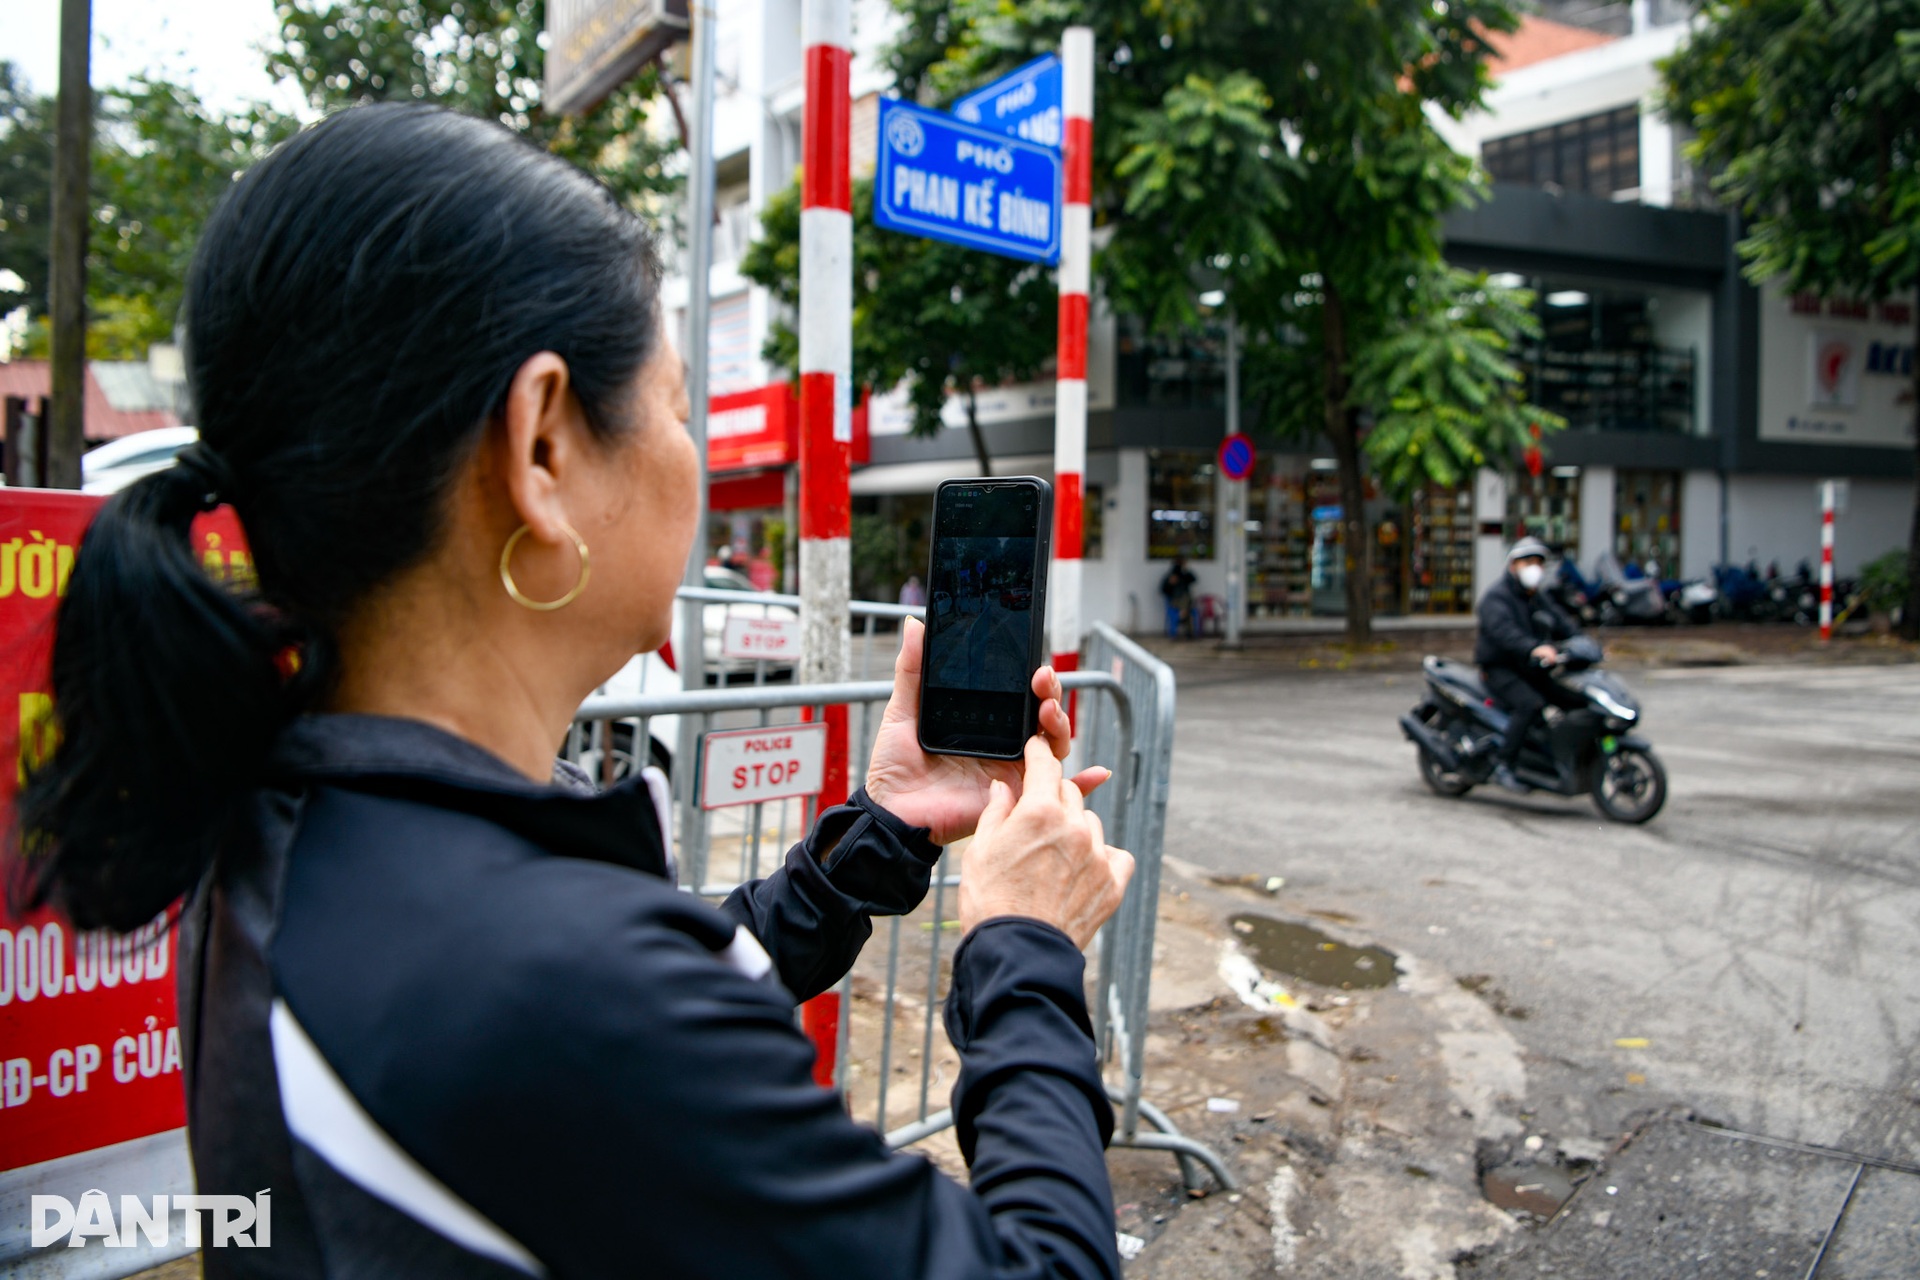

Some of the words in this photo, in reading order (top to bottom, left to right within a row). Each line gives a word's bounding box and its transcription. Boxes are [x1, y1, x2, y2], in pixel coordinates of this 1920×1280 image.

[957, 139, 1014, 174] PHỐ
[894, 164, 959, 220] PHAN
[964, 177, 996, 229] KẾ
[744, 736, 793, 752] POLICE
[732, 760, 800, 790] STOP
[0, 1043, 101, 1110] Đ-CP
[112, 1015, 182, 1083] CỦA
